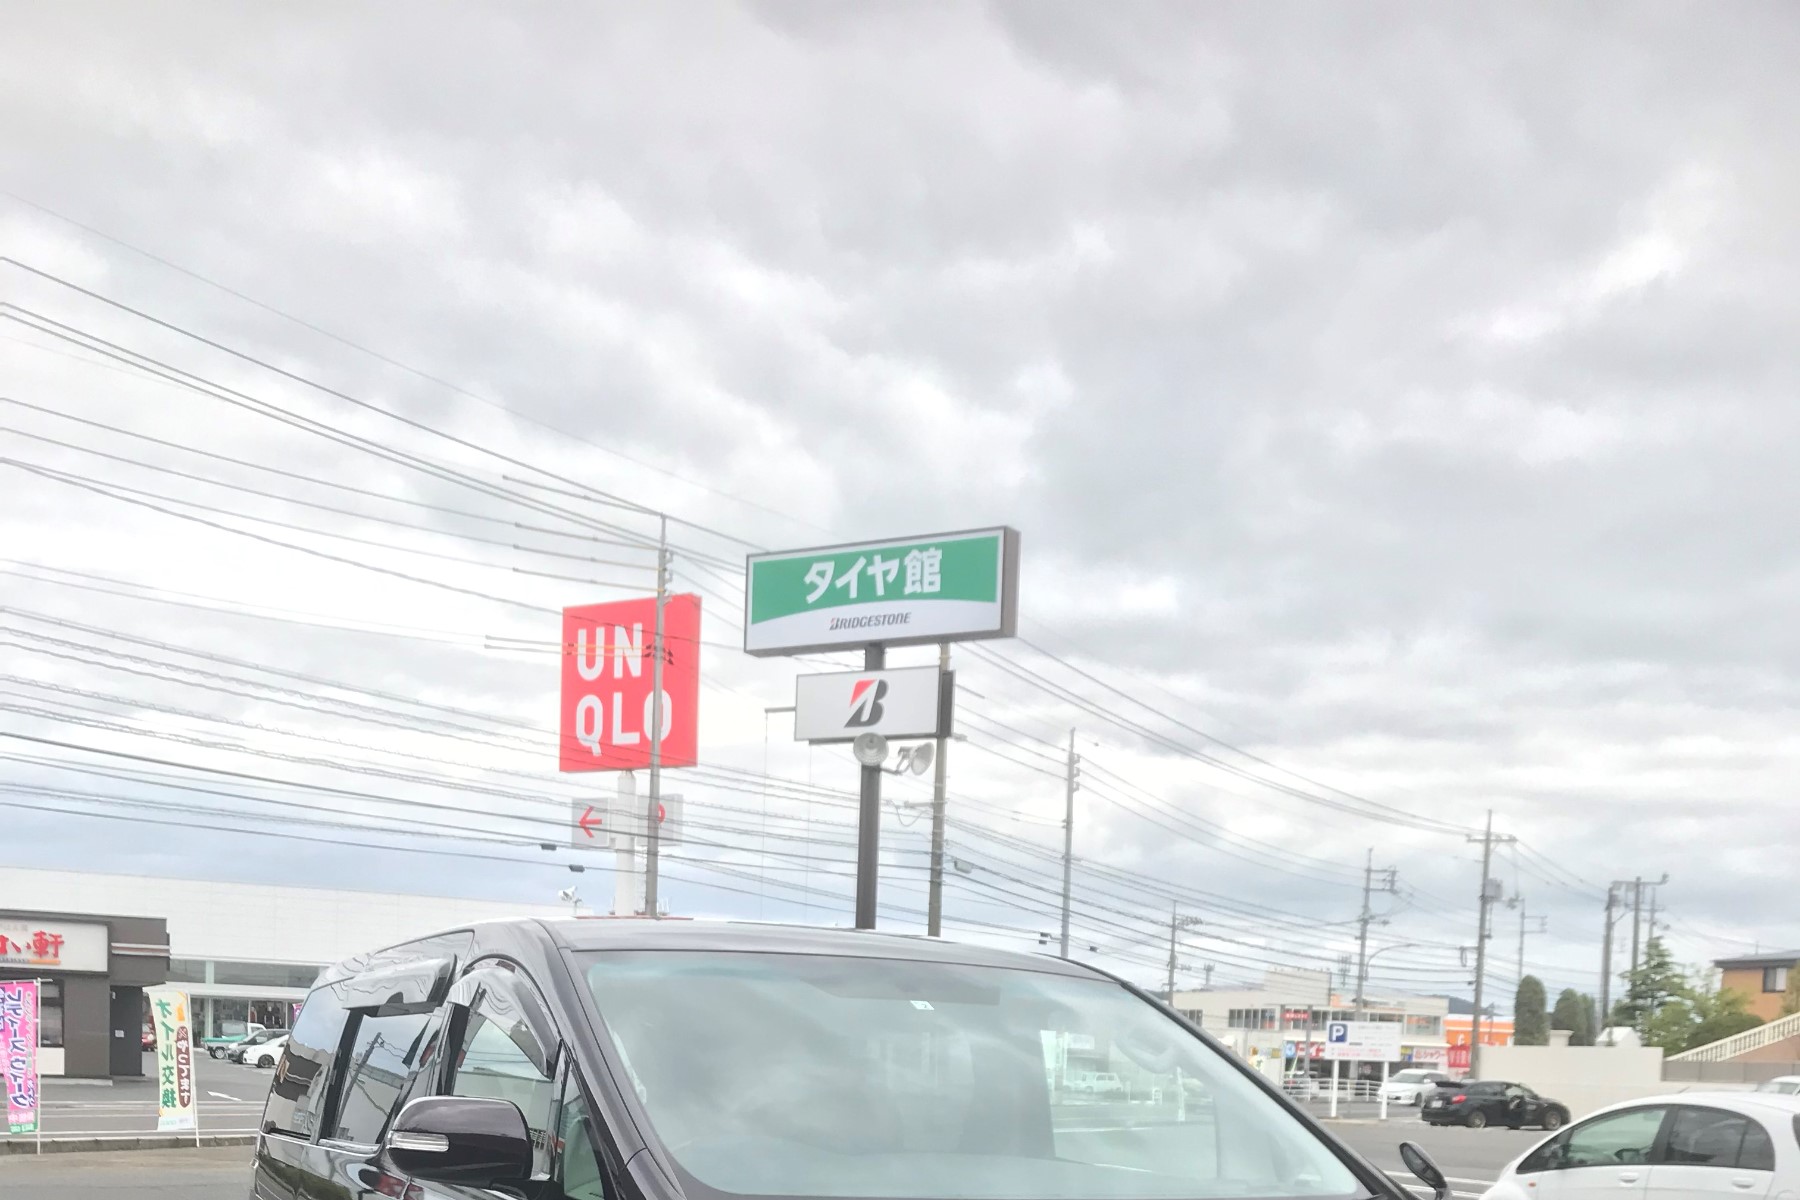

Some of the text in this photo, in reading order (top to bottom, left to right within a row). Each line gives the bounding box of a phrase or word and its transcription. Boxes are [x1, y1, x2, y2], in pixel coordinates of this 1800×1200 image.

[804, 547, 943, 604] タイヤ館
[829, 612, 912, 631] BRIDGESTONE
[577, 623, 643, 681] UN
[576, 689, 673, 756] QLO
